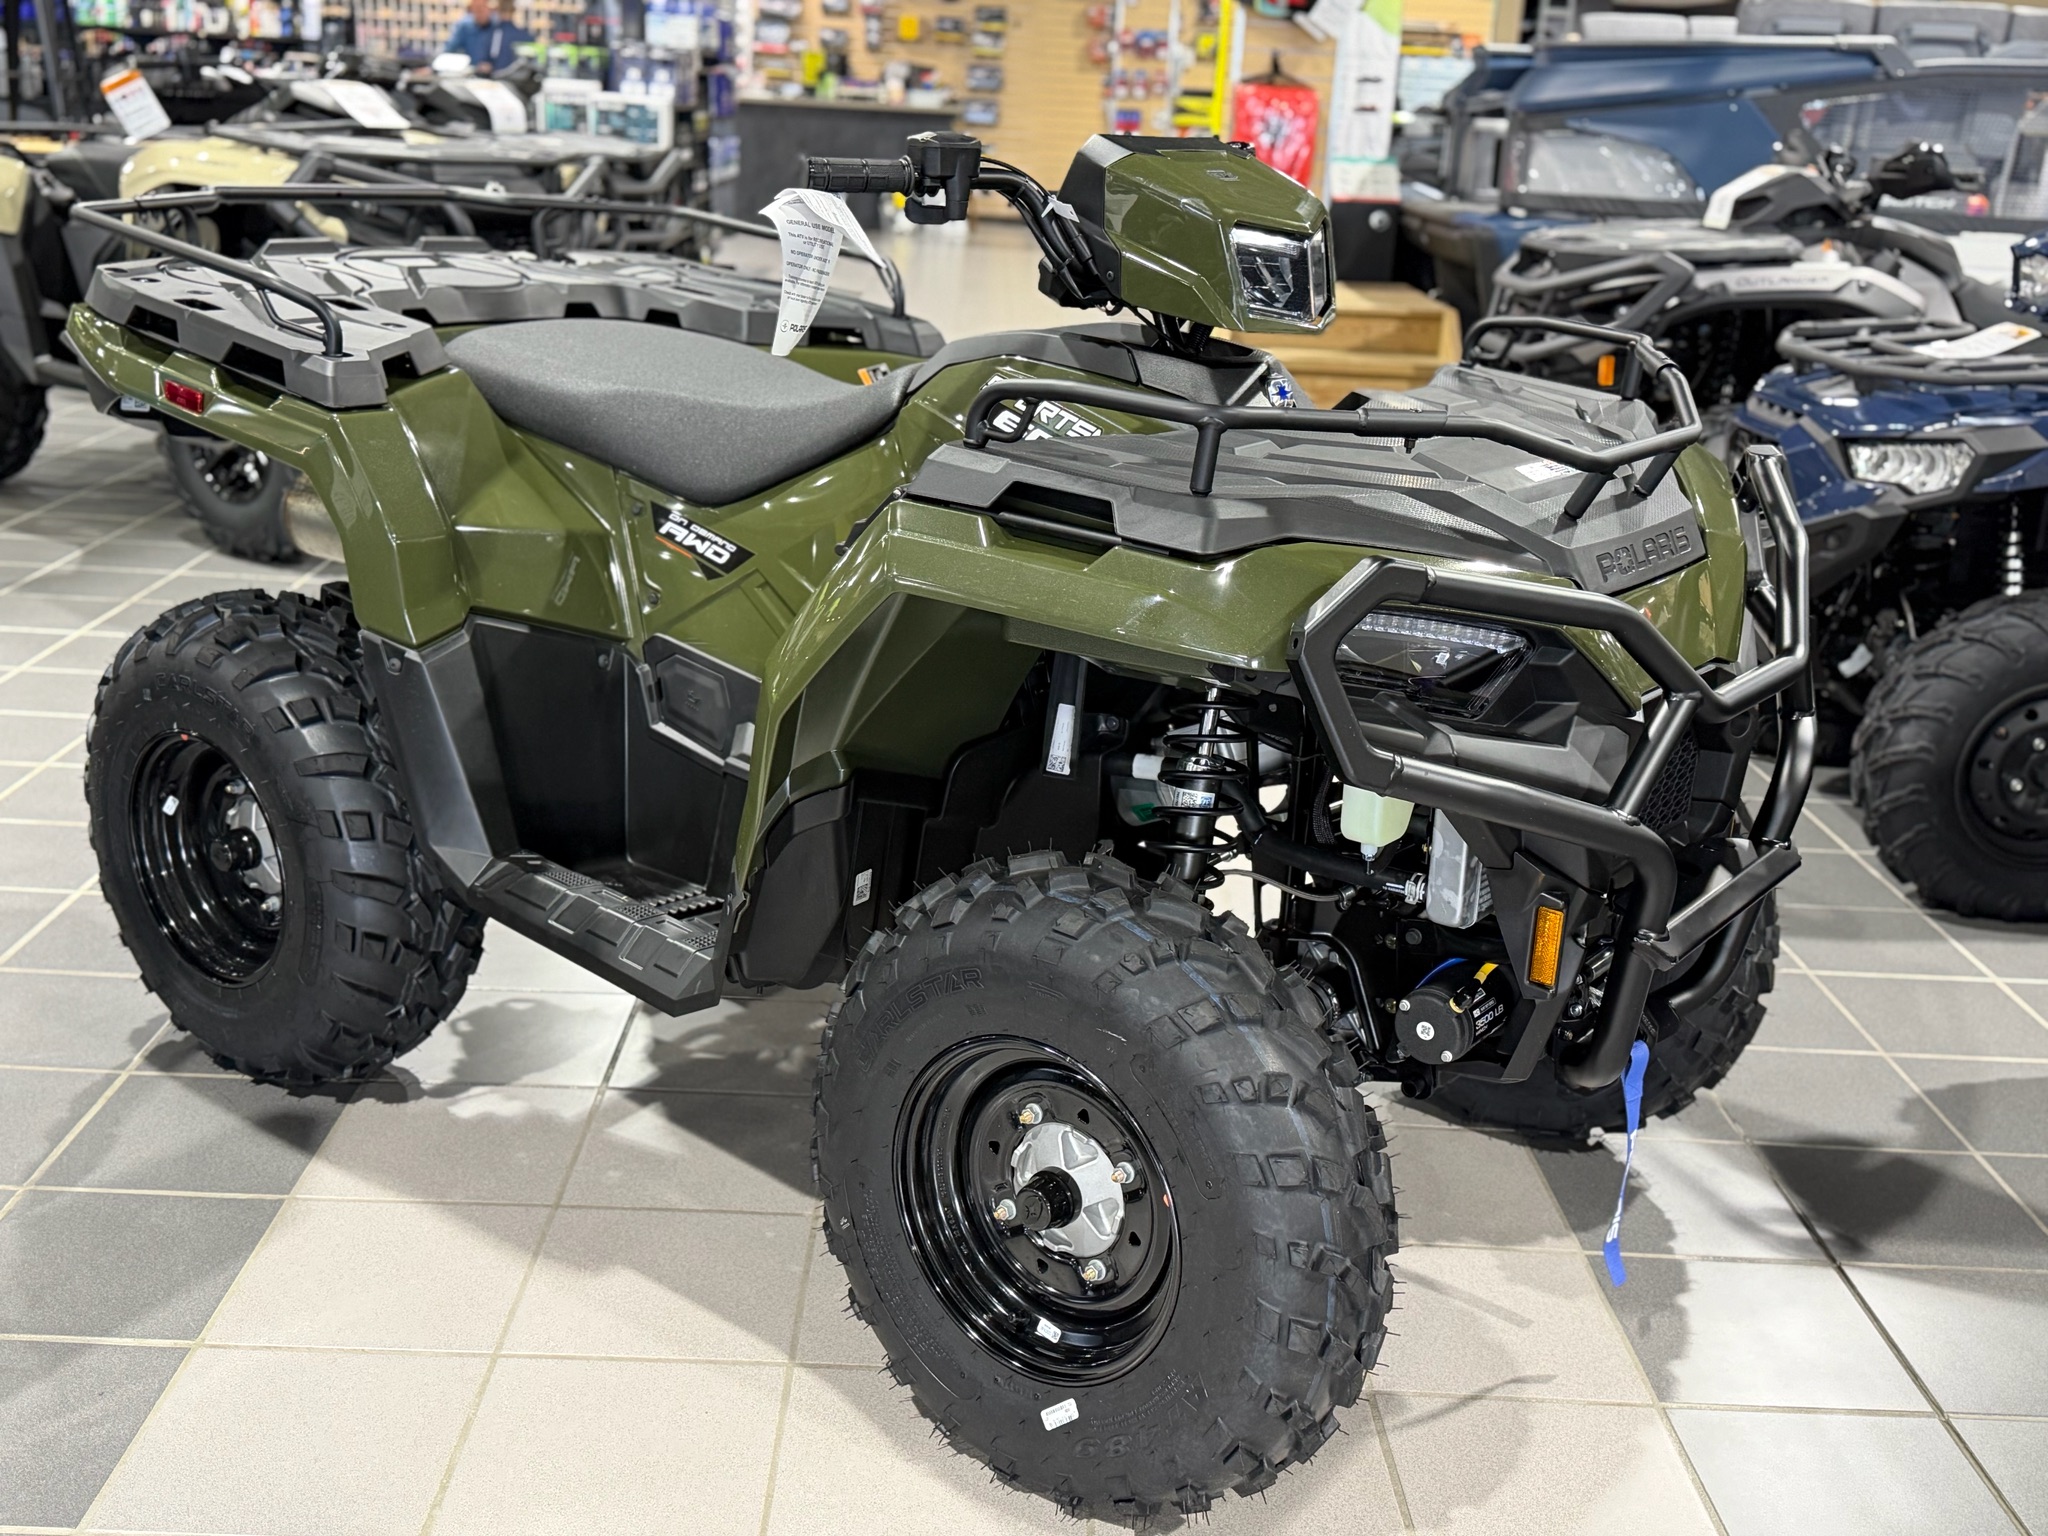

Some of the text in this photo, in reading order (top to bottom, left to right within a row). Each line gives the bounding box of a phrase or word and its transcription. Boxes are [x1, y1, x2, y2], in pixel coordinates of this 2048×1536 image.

[786, 219, 835, 234] GENERAL USE MODEL
[658, 521, 731, 564] AWD
[668, 512, 738, 553] ON DEMAND
[1595, 526, 1692, 583] POLARIS
[858, 968, 984, 1072] CARLSTAR
[1475, 1012, 1494, 1030] 3500
[1494, 1004, 1504, 1016] LB
